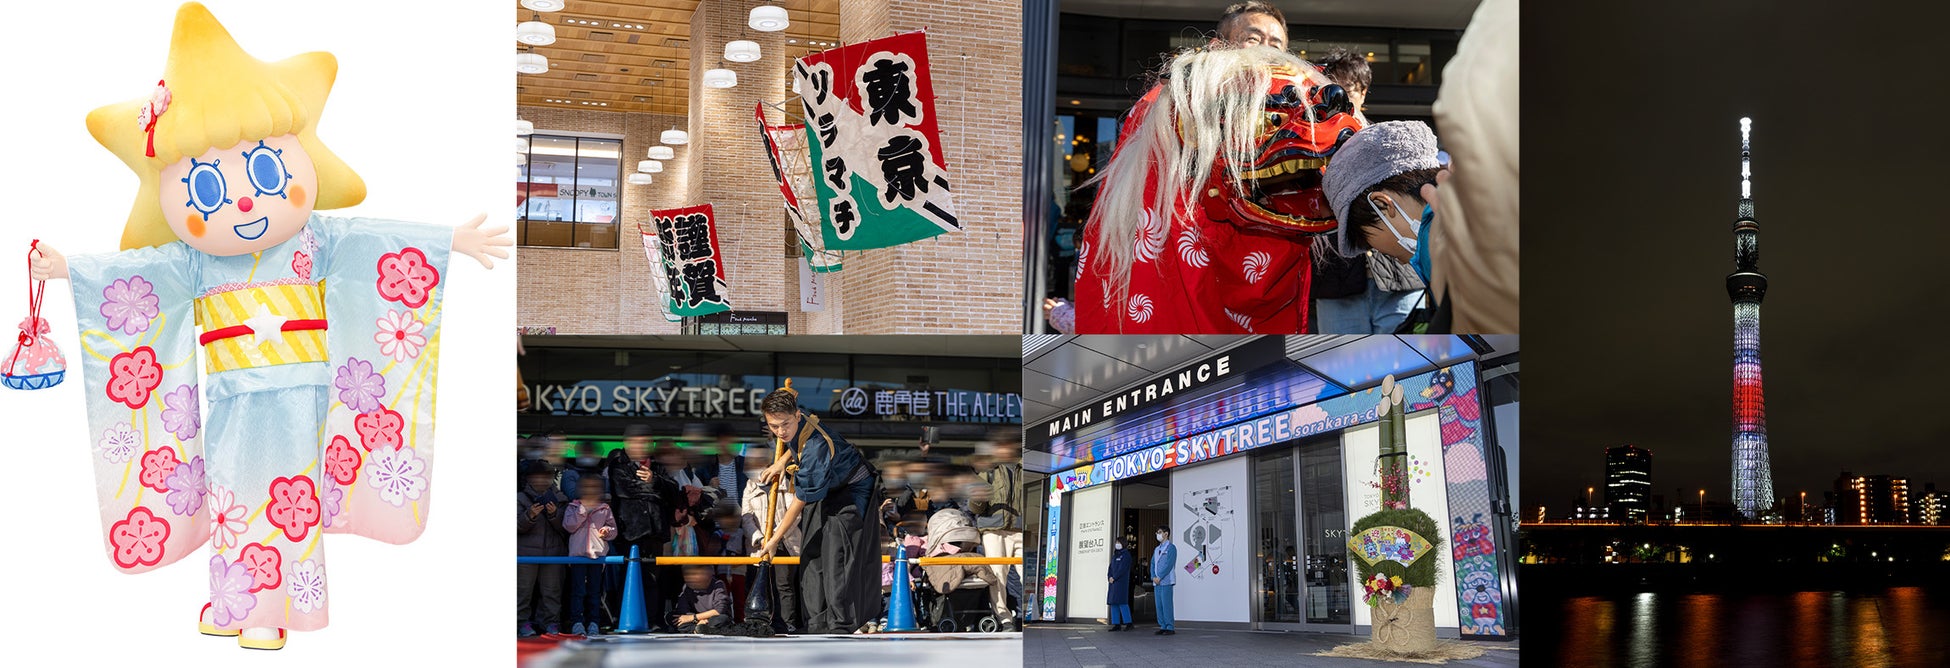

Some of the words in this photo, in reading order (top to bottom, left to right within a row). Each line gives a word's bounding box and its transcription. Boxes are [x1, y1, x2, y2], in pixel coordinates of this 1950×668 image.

[863, 58, 929, 203] 東京
[674, 213, 721, 306] 謹賀
[612, 385, 766, 414] SKYTREE
[934, 392, 967, 416] THE
[973, 392, 1022, 417] ALLEY
[1049, 408, 1092, 437] MAIN
[1103, 355, 1230, 417] ENTRANCE
[1102, 446, 1166, 482] TOKYO
[1176, 412, 1291, 466] SKYTREE
